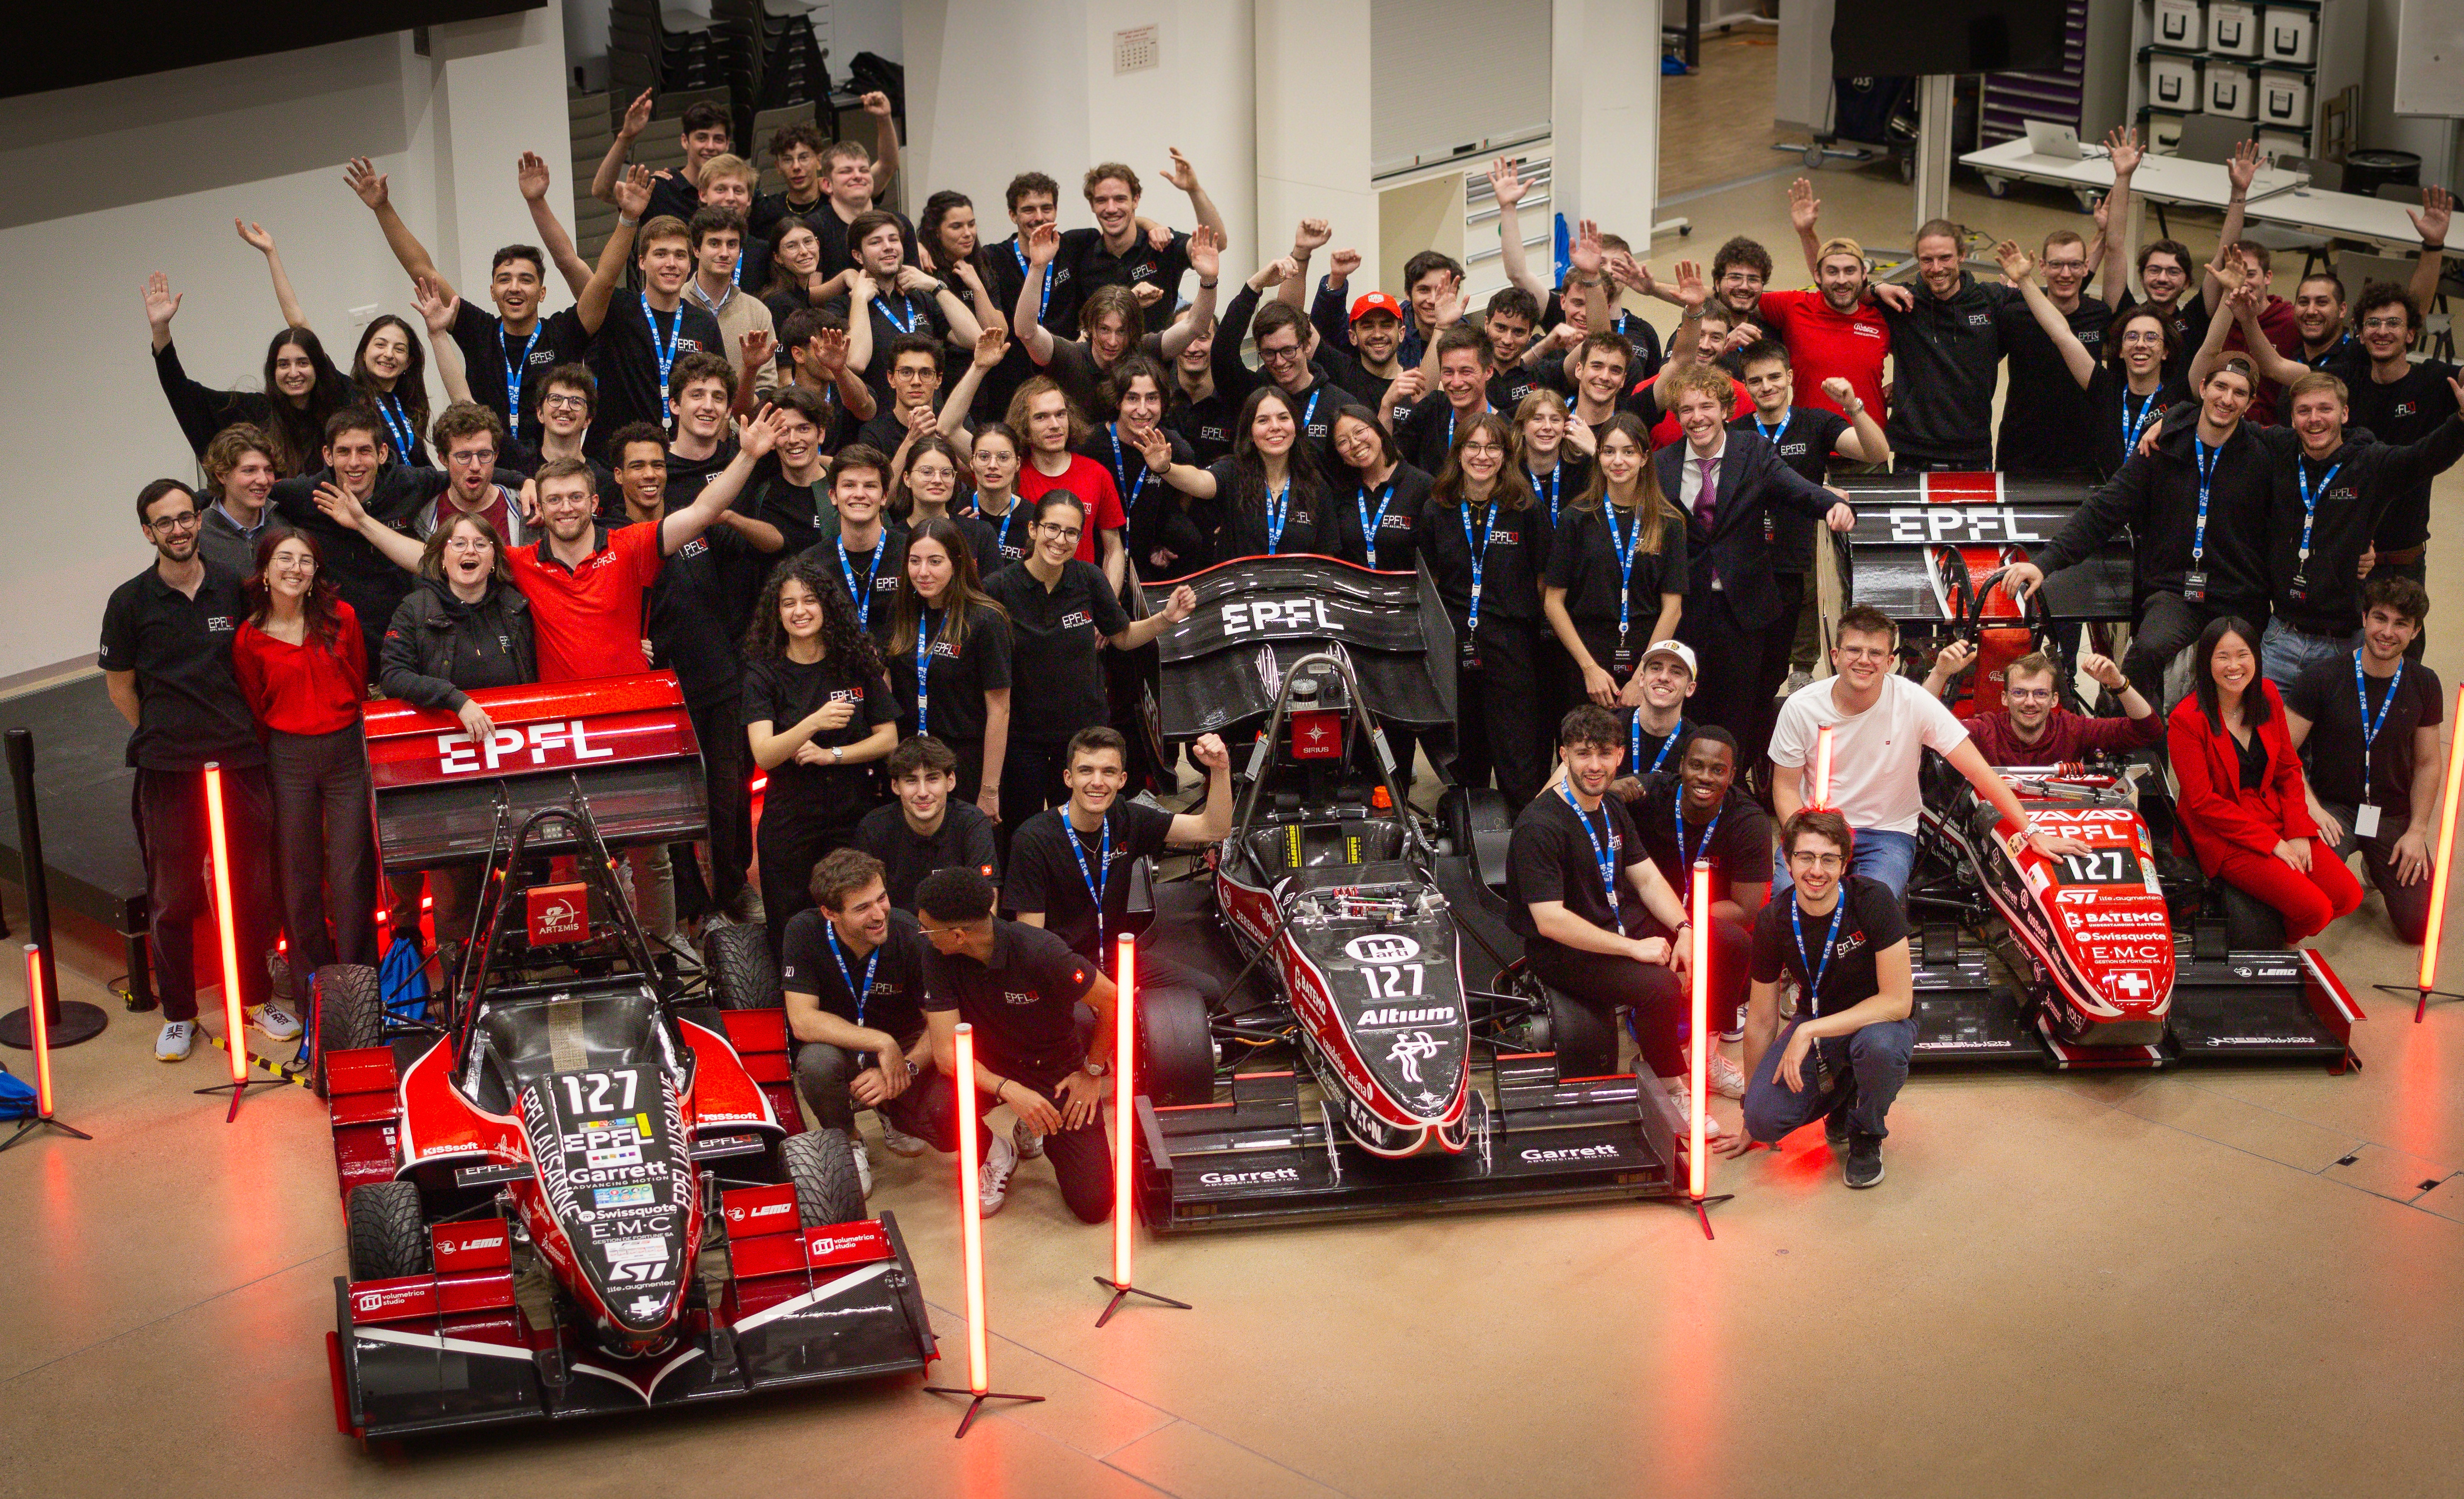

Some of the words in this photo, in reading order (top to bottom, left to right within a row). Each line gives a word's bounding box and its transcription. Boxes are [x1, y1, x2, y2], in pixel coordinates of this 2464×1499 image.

[1132, 265, 1150, 277] EPFL
[678, 339, 694, 350] EPFL
[1393, 407, 1410, 419] EPF
[1202, 426, 1222, 438] EPFL
[1382, 515, 1403, 526] EPFL
[1890, 507, 2039, 541] EPFL
[1490, 531, 1510, 542] EPFL
[208, 617, 228, 629] EPFL
[1062, 612, 1084, 626] EPFL
[1221, 599, 1344, 636] EPFL
[437, 720, 614, 775] EPFL
[1303, 746, 1329, 754] SIRIUS
[2040, 824, 2128, 840] EPFL
[2063, 852, 2123, 880] 127
[2001, 881, 2018, 906] Garrett
[2055, 889, 2098, 904] ST
[2088, 913, 2163, 922] BATEMO
[2027, 912, 2047, 942] KISSsoft
[2092, 932, 2166, 942] Swissquote
[1356, 937, 1409, 959] marti
[1361, 964, 1424, 998] 127
[1301, 977, 1326, 1015] BATEMO
[1357, 1006, 1454, 1026] Altium
[2067, 1004, 2082, 1026] VOLT
[1322, 1036, 1346, 1075] vaudoise
[1348, 1072, 1367, 1098] aréna
[562, 1069, 638, 1114] 127
[521, 1086, 545, 1131] EPFL
[660, 1071, 691, 1171] LAUSANNE
[703, 1112, 758, 1121] KISSsoft
[565, 1128, 654, 1152] EPFL
[699, 1137, 743, 1148] EPFL
[423, 1141, 478, 1155] KISSsoft
[1521, 1145, 1618, 1160] Garrett
[1527, 1155, 1580, 1164] ADVANCING
[465, 1165, 511, 1175] EPFL
[531, 1123, 581, 1224] LAUSANNE
[569, 1161, 668, 1184] Garrett
[1200, 1167, 1297, 1184] Garrett
[573, 1180, 622, 1190] ADVANCING
[626, 1175, 669, 1184] MOTION
[673, 1171, 692, 1210] EPFL
[596, 1204, 677, 1220] Swissquote
[751, 1203, 792, 1217] LEMO
[460, 1236, 503, 1251] LEMO
[593, 1236, 622, 1245] GESTION
[834, 1234, 874, 1243] volumetrica
[609, 1261, 667, 1281] ST
[606, 1280, 676, 1293] life.augmented
[382, 1290, 425, 1300] volumetrica
